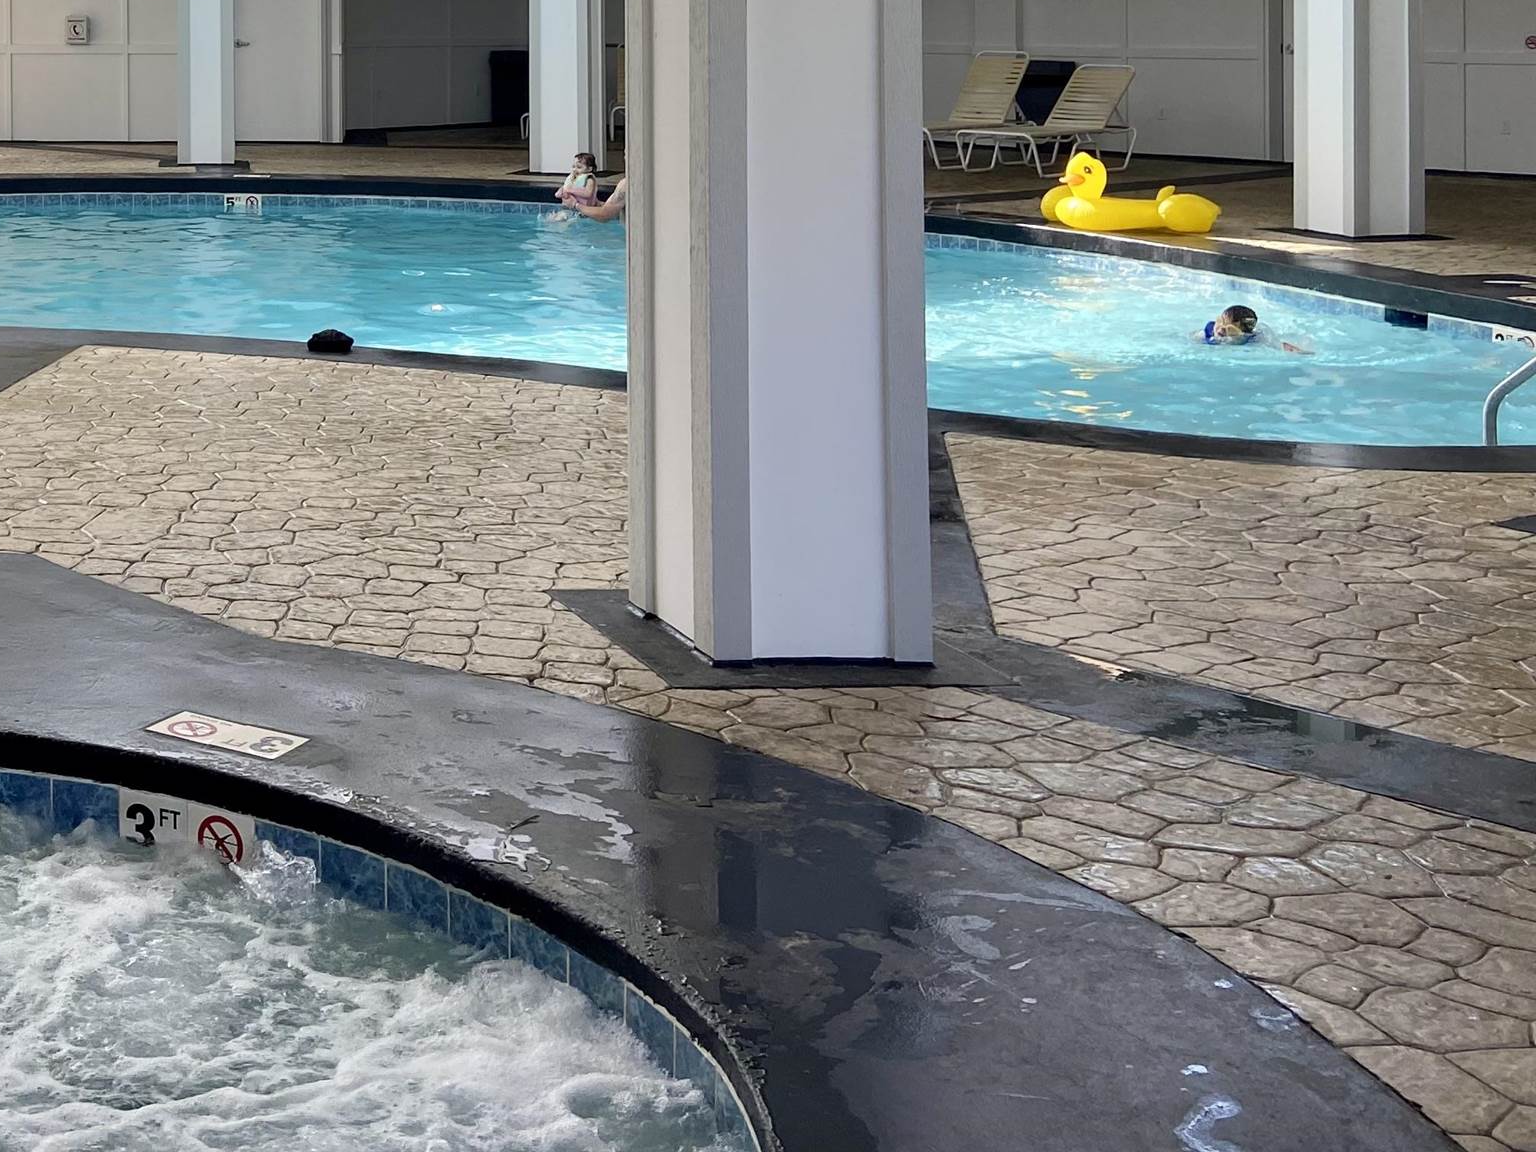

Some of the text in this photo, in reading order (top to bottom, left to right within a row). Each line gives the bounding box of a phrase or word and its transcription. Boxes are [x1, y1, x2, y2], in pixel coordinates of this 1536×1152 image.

[226, 197, 235, 207] 5
[249, 736, 294, 753] 3
[126, 803, 181, 847] 3 FT
